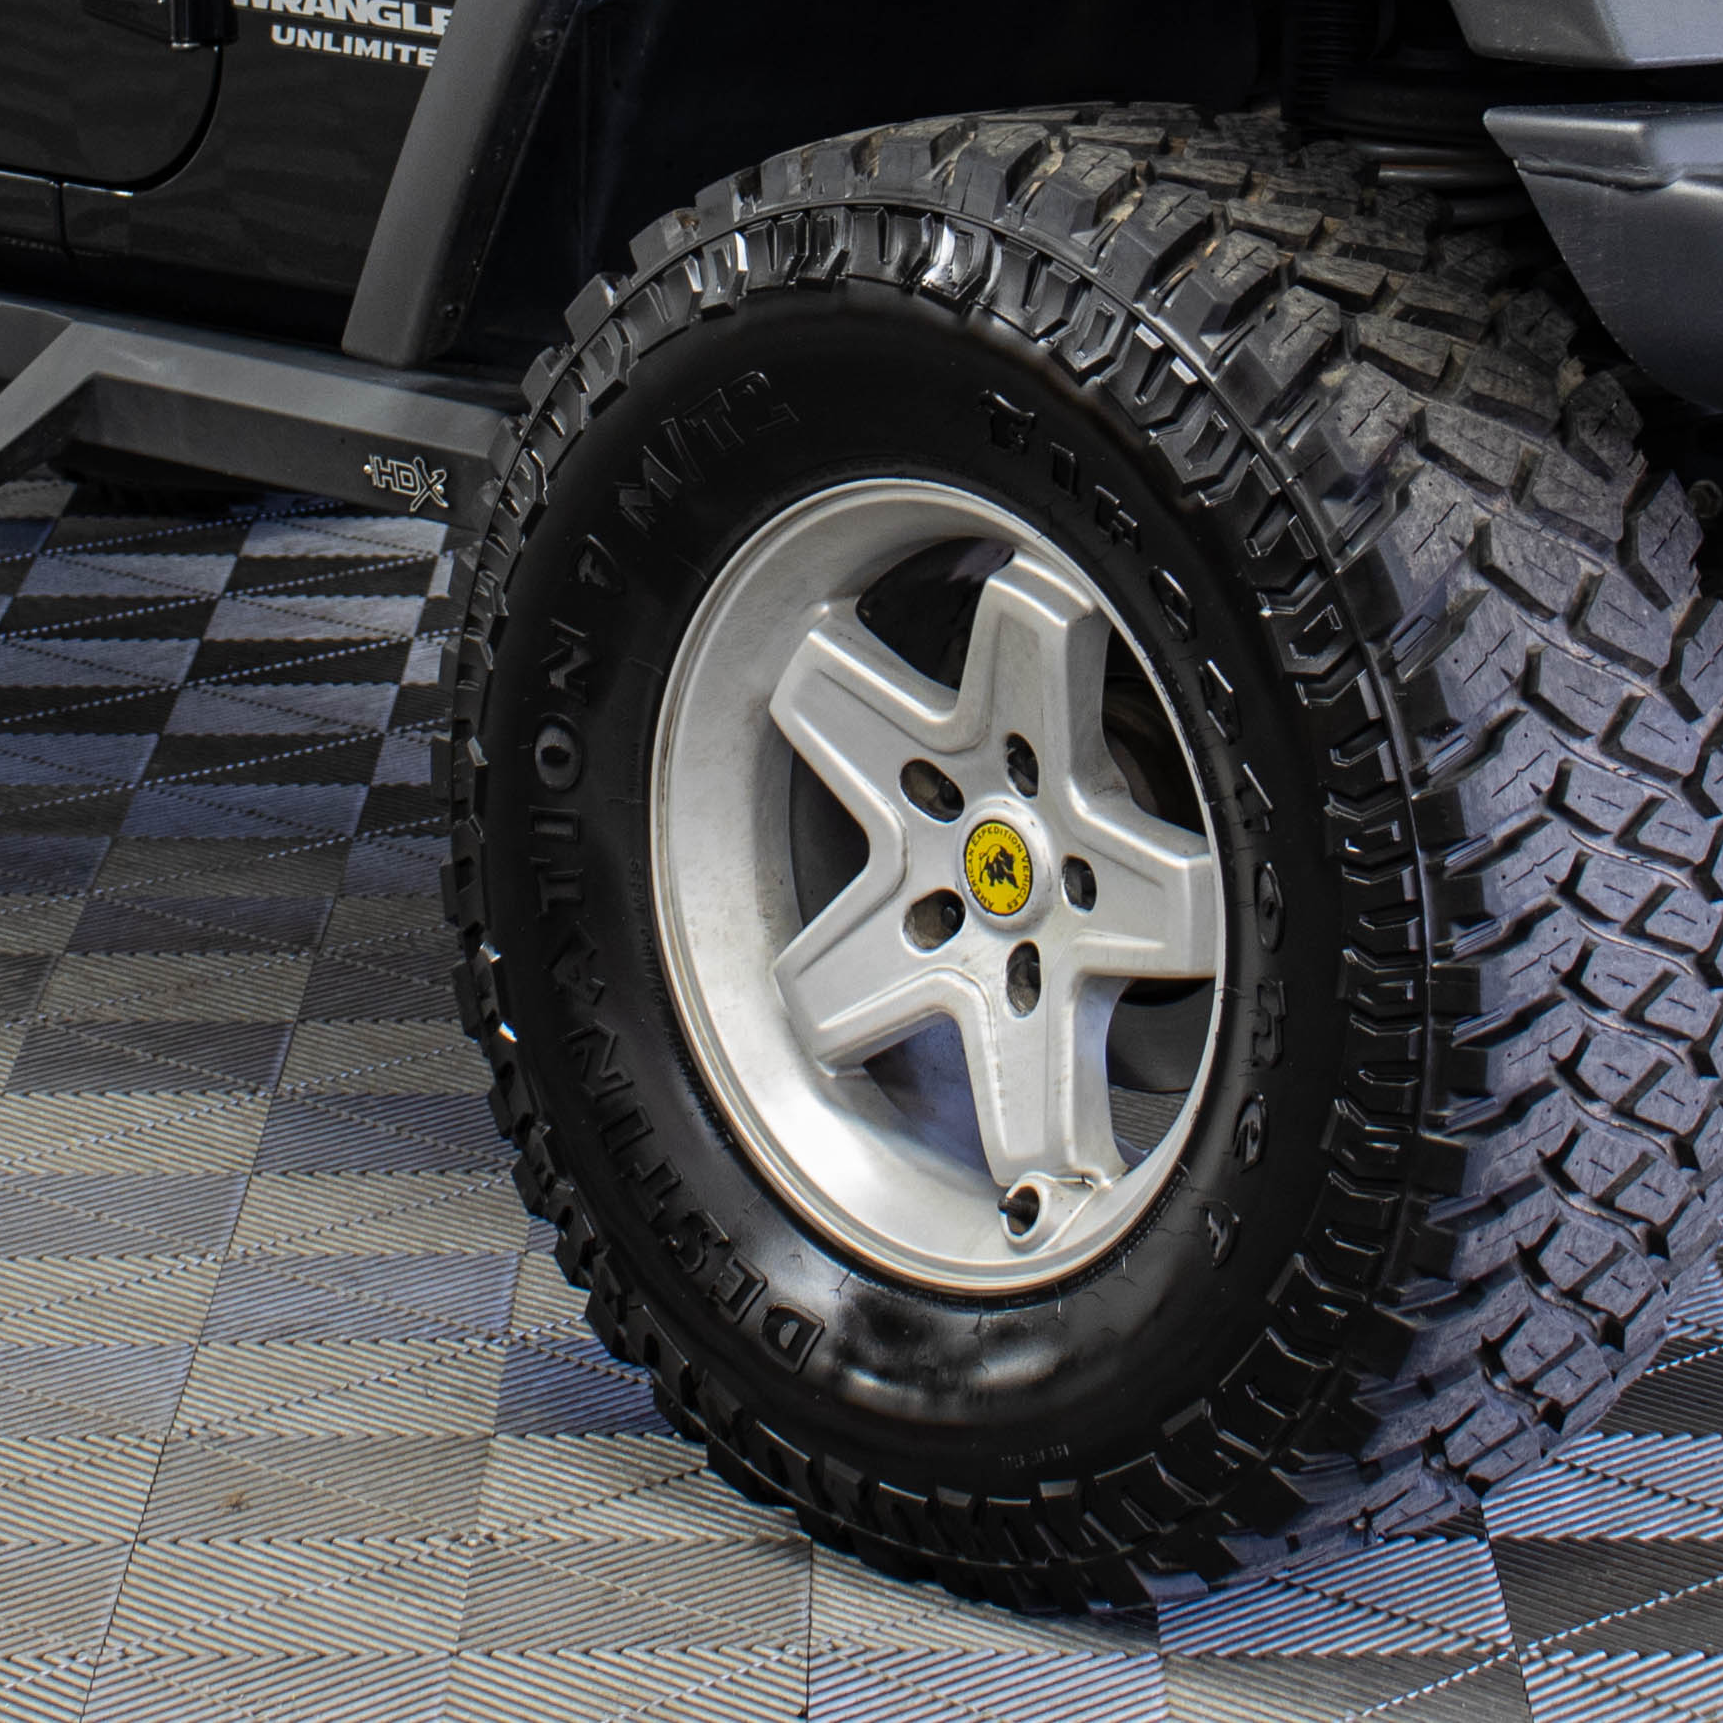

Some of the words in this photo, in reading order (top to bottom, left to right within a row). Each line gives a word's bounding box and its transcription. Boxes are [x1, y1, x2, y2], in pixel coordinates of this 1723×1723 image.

[271, 24, 438, 68] UNLIMITE
[368, 453, 450, 513] HDX
[527, 617, 825, 1375] DESTINATION
